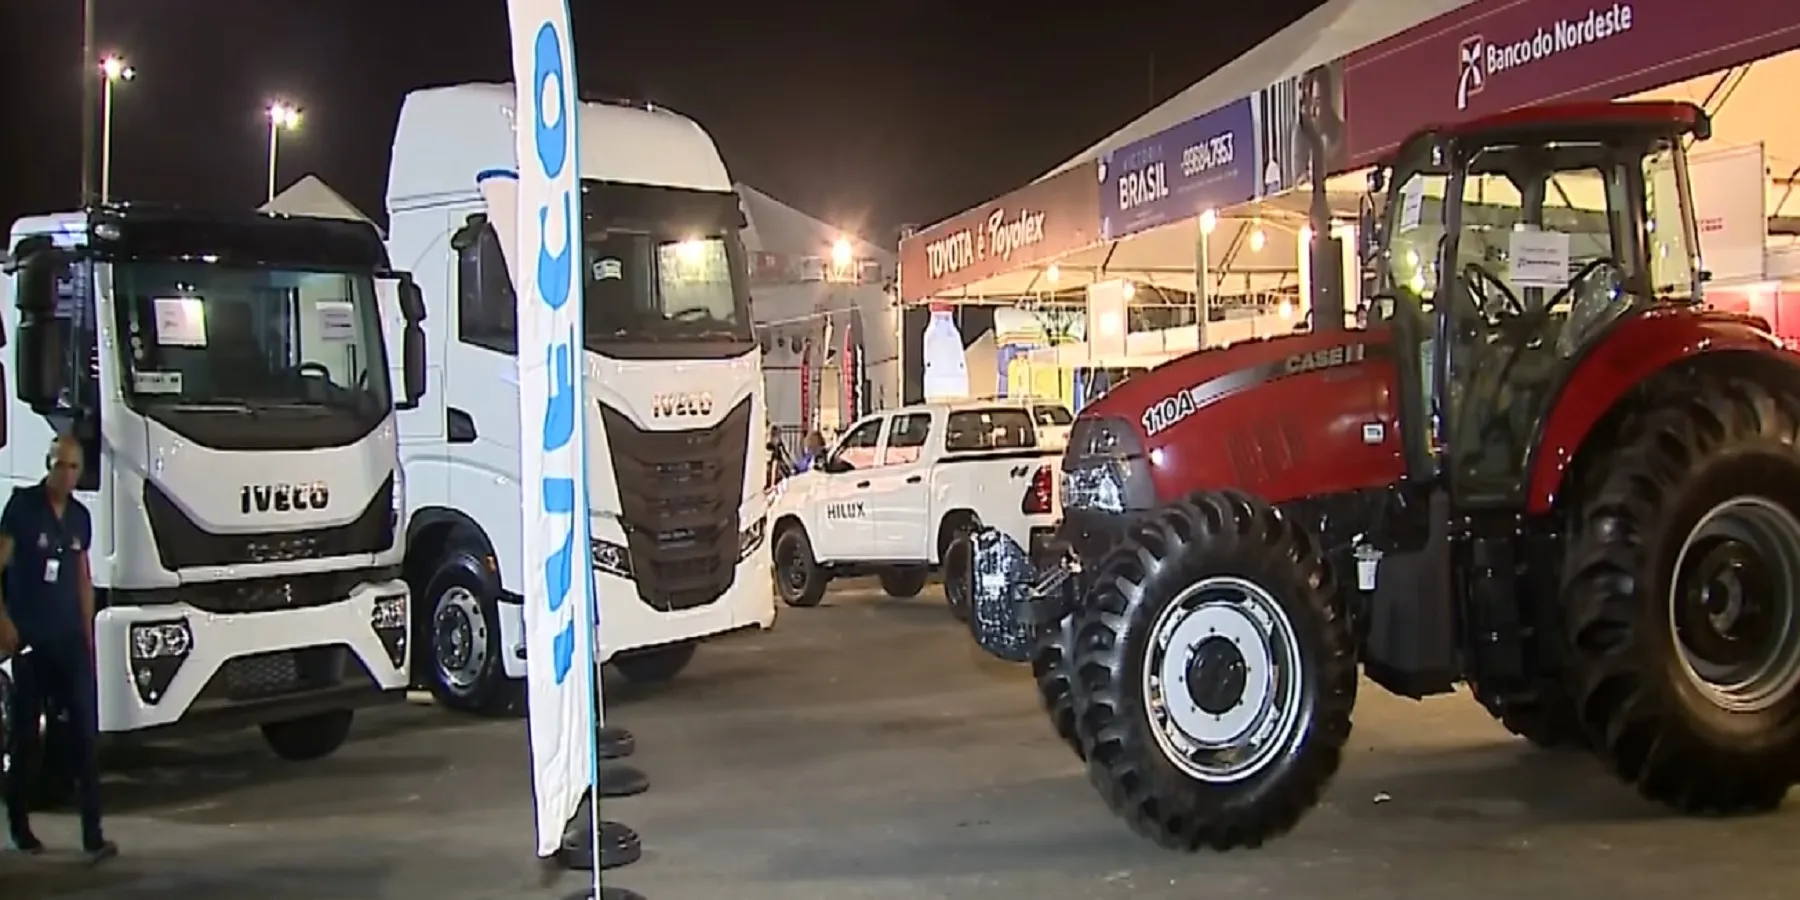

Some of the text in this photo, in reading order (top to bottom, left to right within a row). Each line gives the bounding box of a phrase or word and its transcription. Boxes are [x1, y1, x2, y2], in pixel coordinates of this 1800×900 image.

[1486, 3, 1632, 74] Banco do Nordeste
[1119, 161, 1169, 211] BRASIL
[926, 228, 974, 279] TOYOTA
[988, 207, 1045, 262] Toyolex
[1284, 347, 1344, 374] CASE
[653, 392, 713, 419] IVECO
[1142, 388, 1195, 436] 110A
[241, 481, 329, 514] IVECO
[827, 501, 867, 519] HILUX
